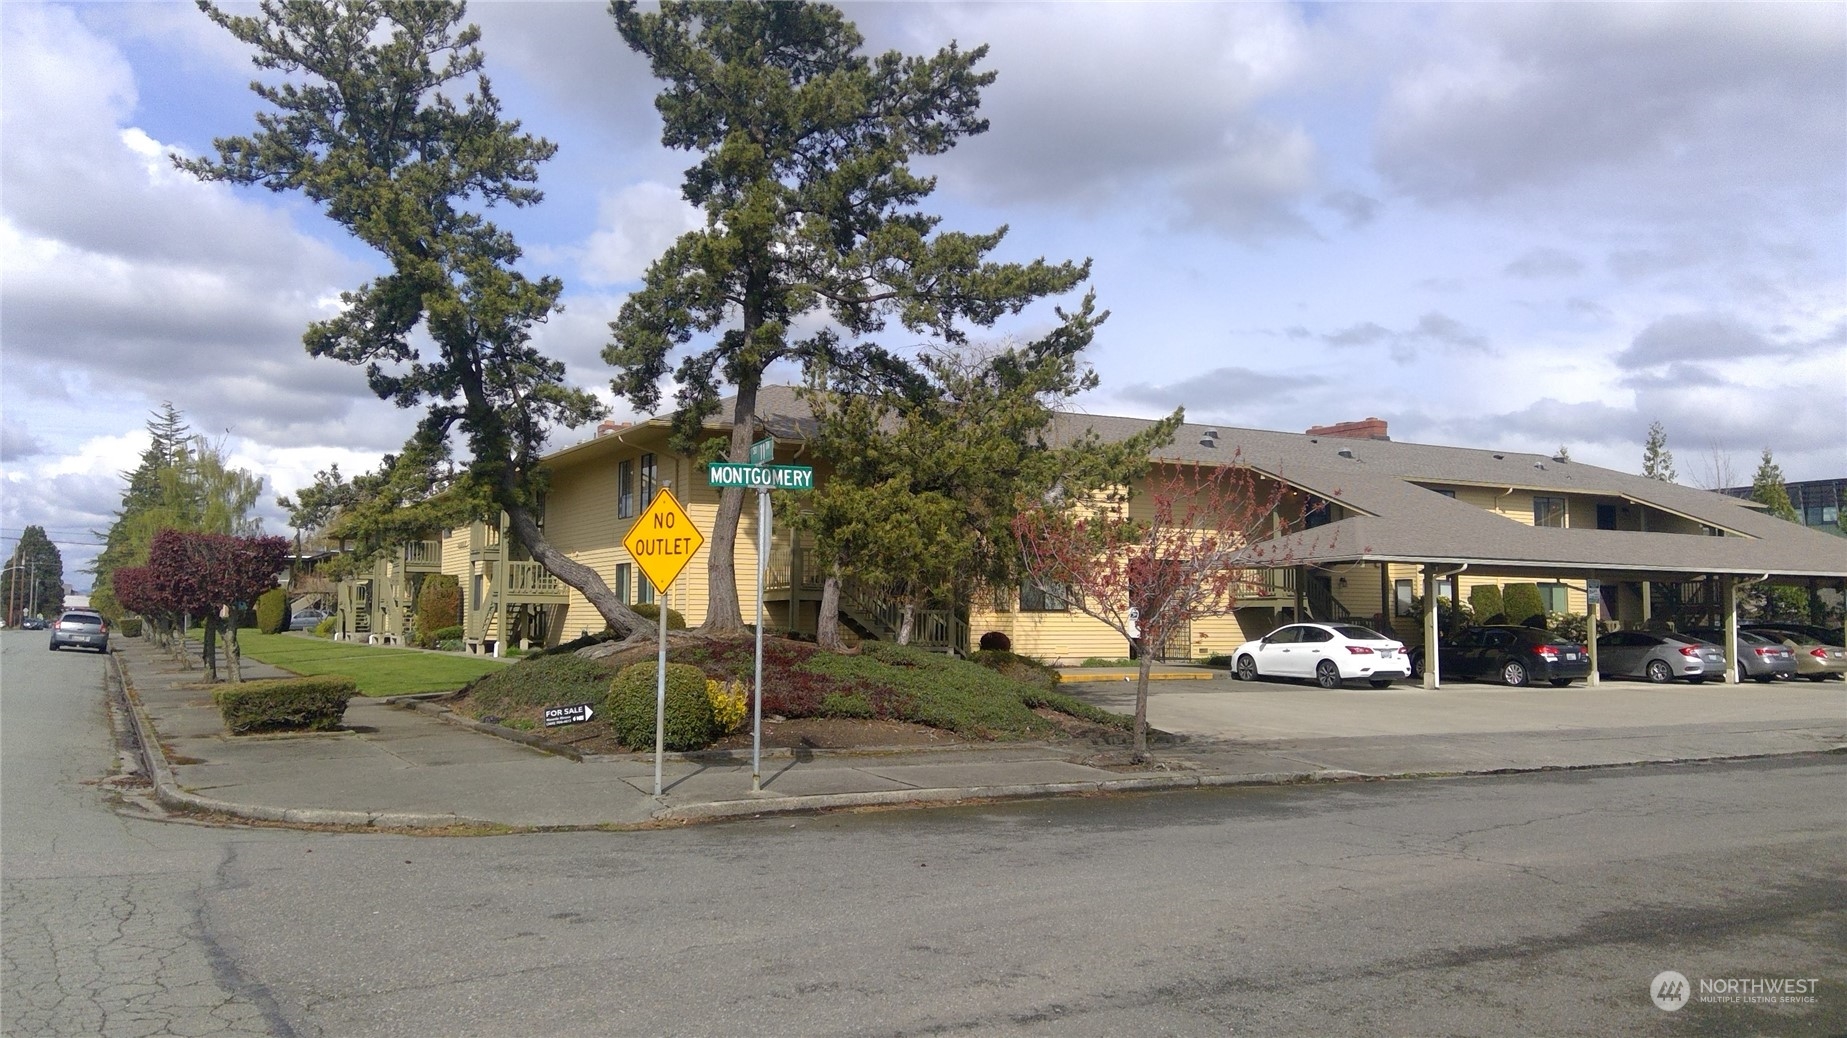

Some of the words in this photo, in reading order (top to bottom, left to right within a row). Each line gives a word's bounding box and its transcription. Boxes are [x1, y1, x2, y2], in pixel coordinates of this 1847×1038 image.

[711, 466, 812, 487] MONTGOMERY
[654, 512, 675, 529] NO
[635, 538, 691, 556] OUTLET
[546, 709, 563, 718] FOR
[564, 706, 583, 715] SALE
